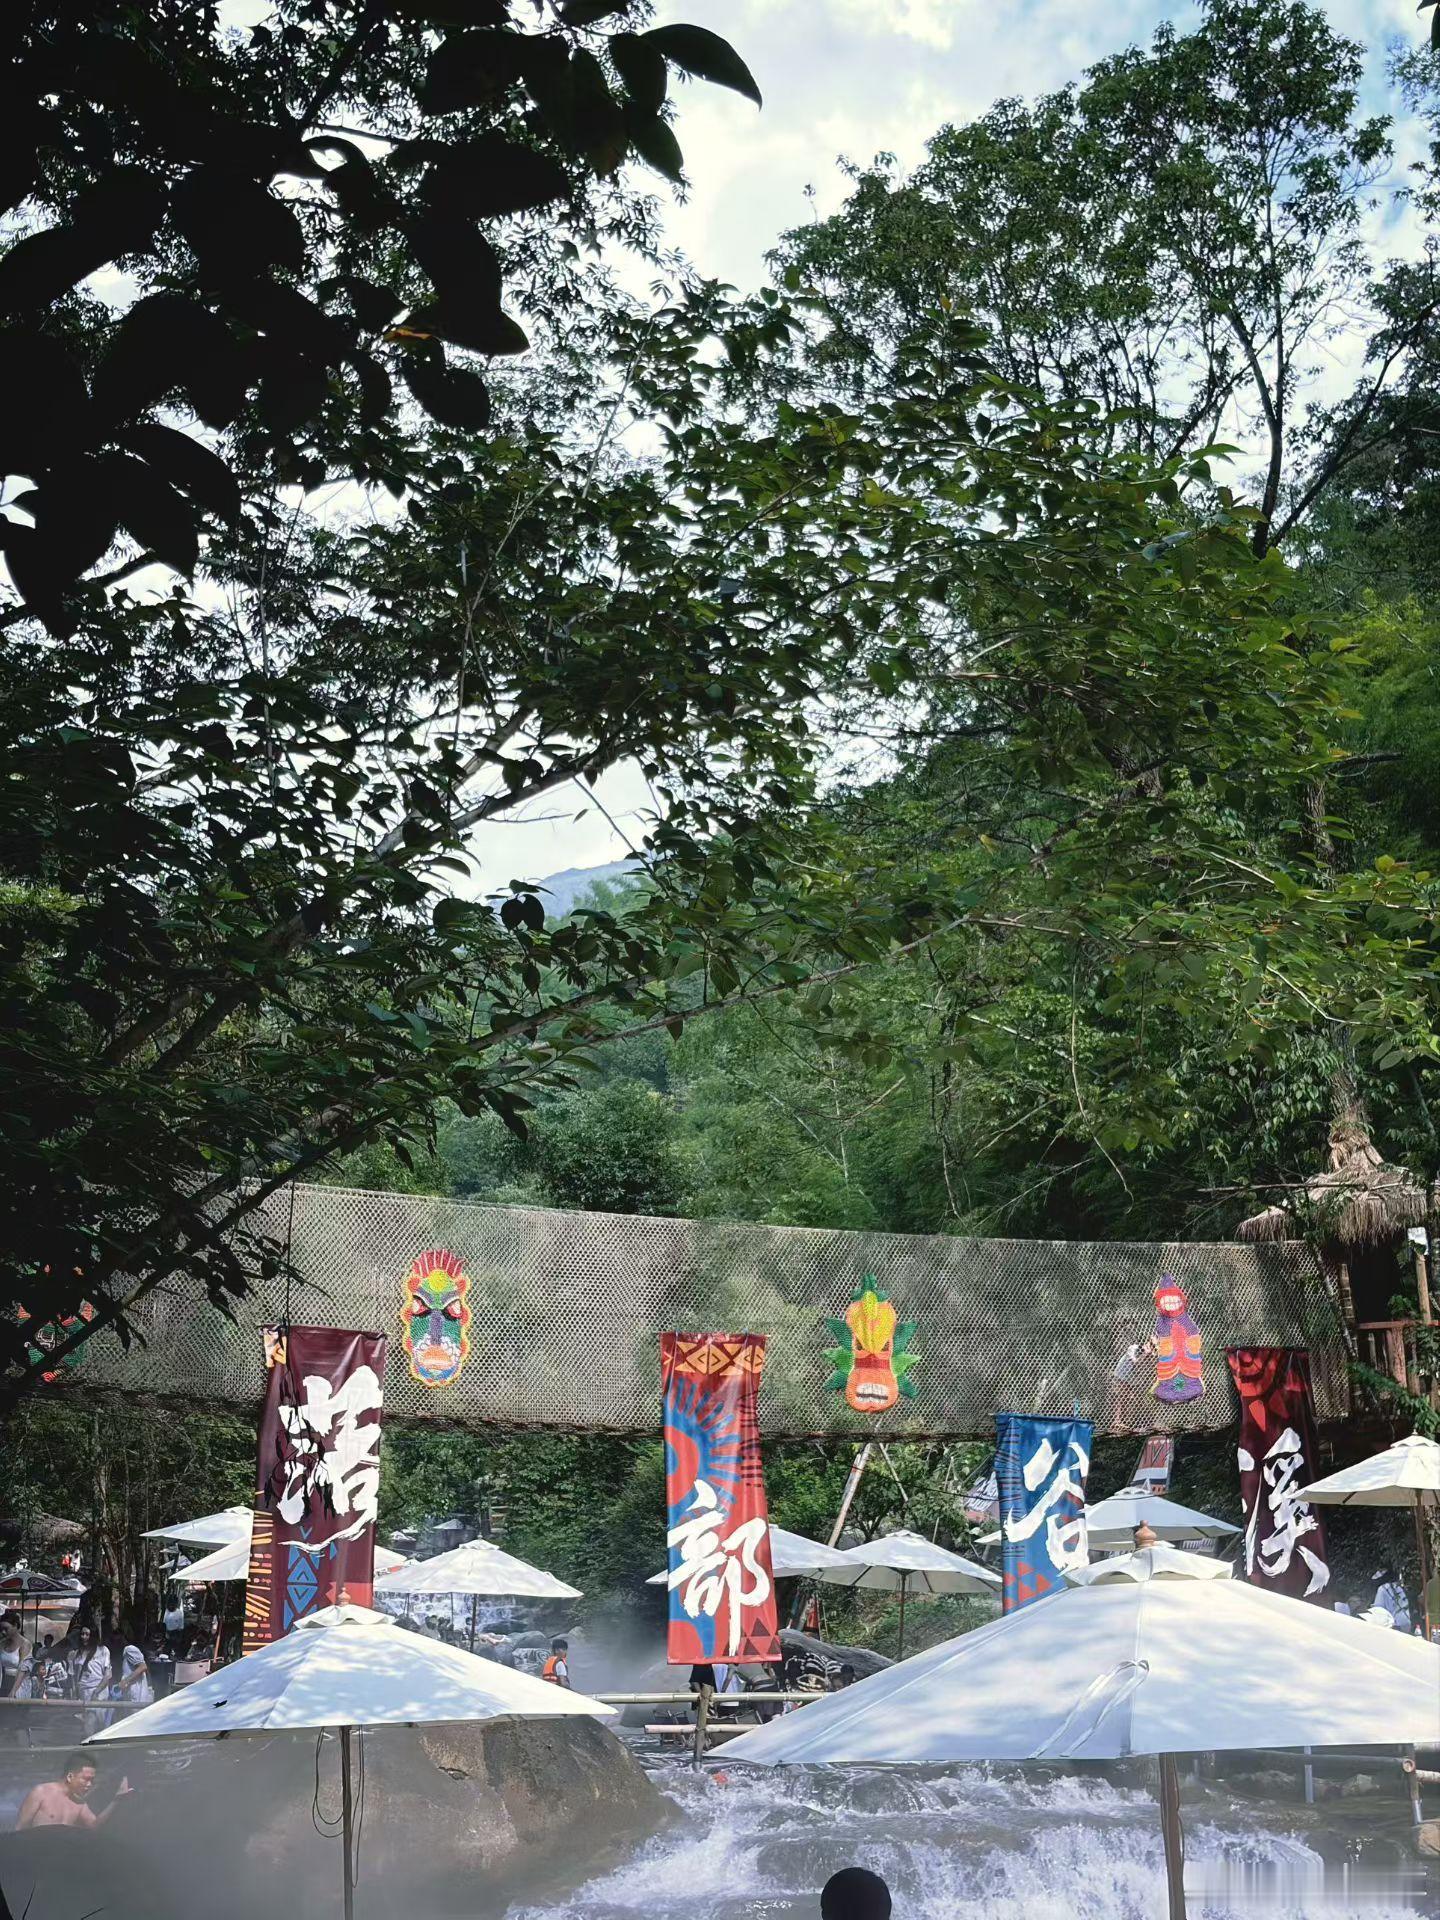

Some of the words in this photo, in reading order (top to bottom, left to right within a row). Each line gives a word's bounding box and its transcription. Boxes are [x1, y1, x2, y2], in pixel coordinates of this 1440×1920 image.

[667, 1479, 770, 1657] 部
[1003, 1438, 1090, 1577] 谷
[1237, 1427, 1331, 1597] 溪
